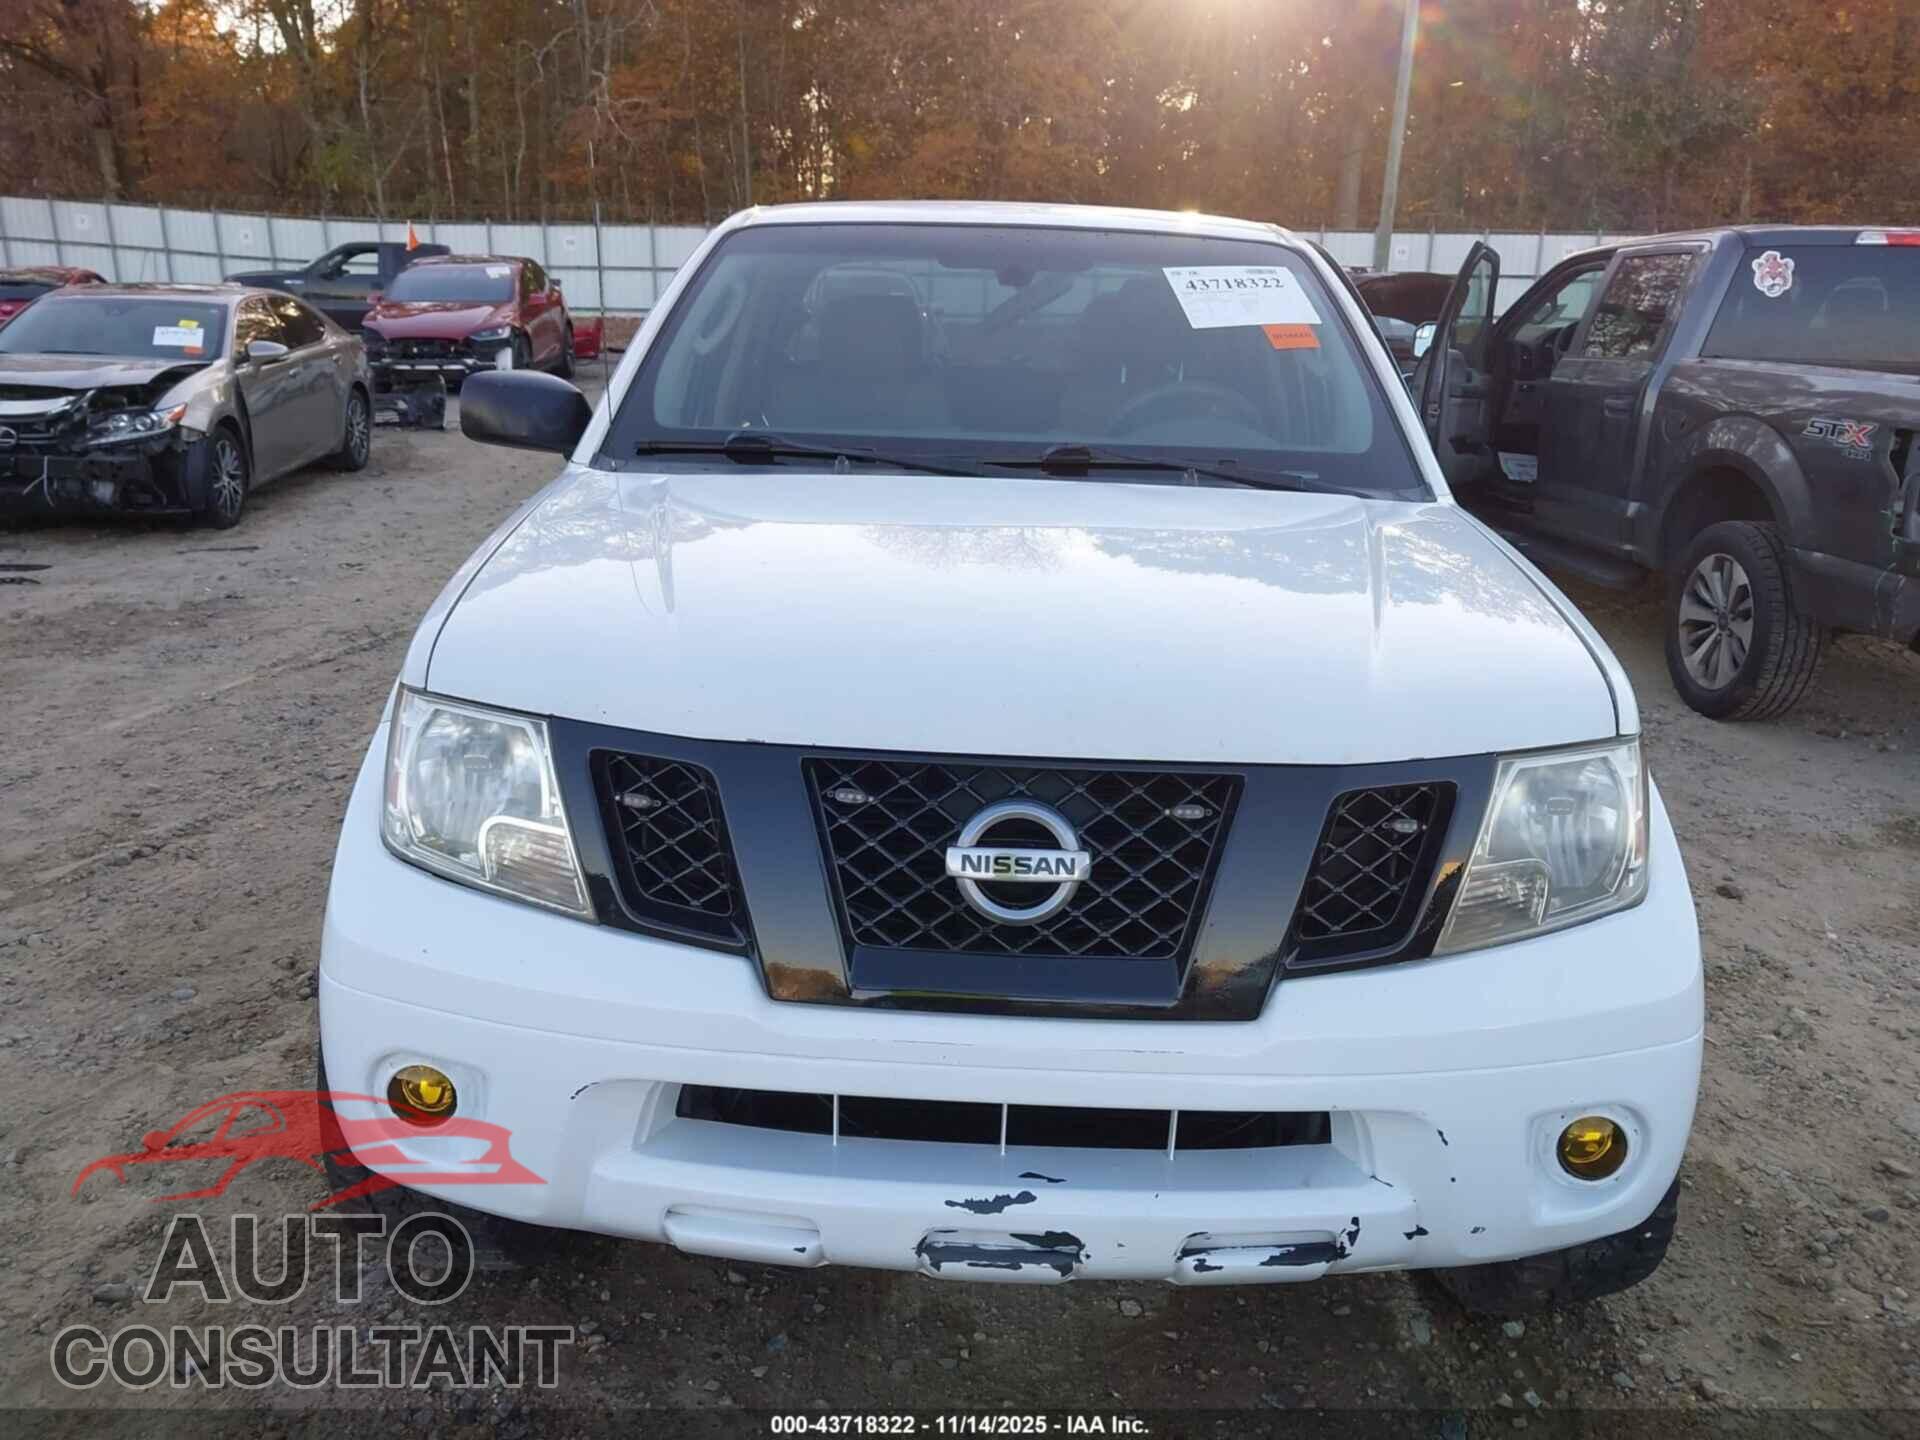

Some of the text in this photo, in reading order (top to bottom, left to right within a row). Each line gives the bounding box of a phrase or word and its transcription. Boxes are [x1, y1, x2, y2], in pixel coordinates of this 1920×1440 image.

[1186, 278, 1285, 291] 43718322
[1801, 417, 1878, 448] STX
[960, 854, 1076, 876] NISSAN
